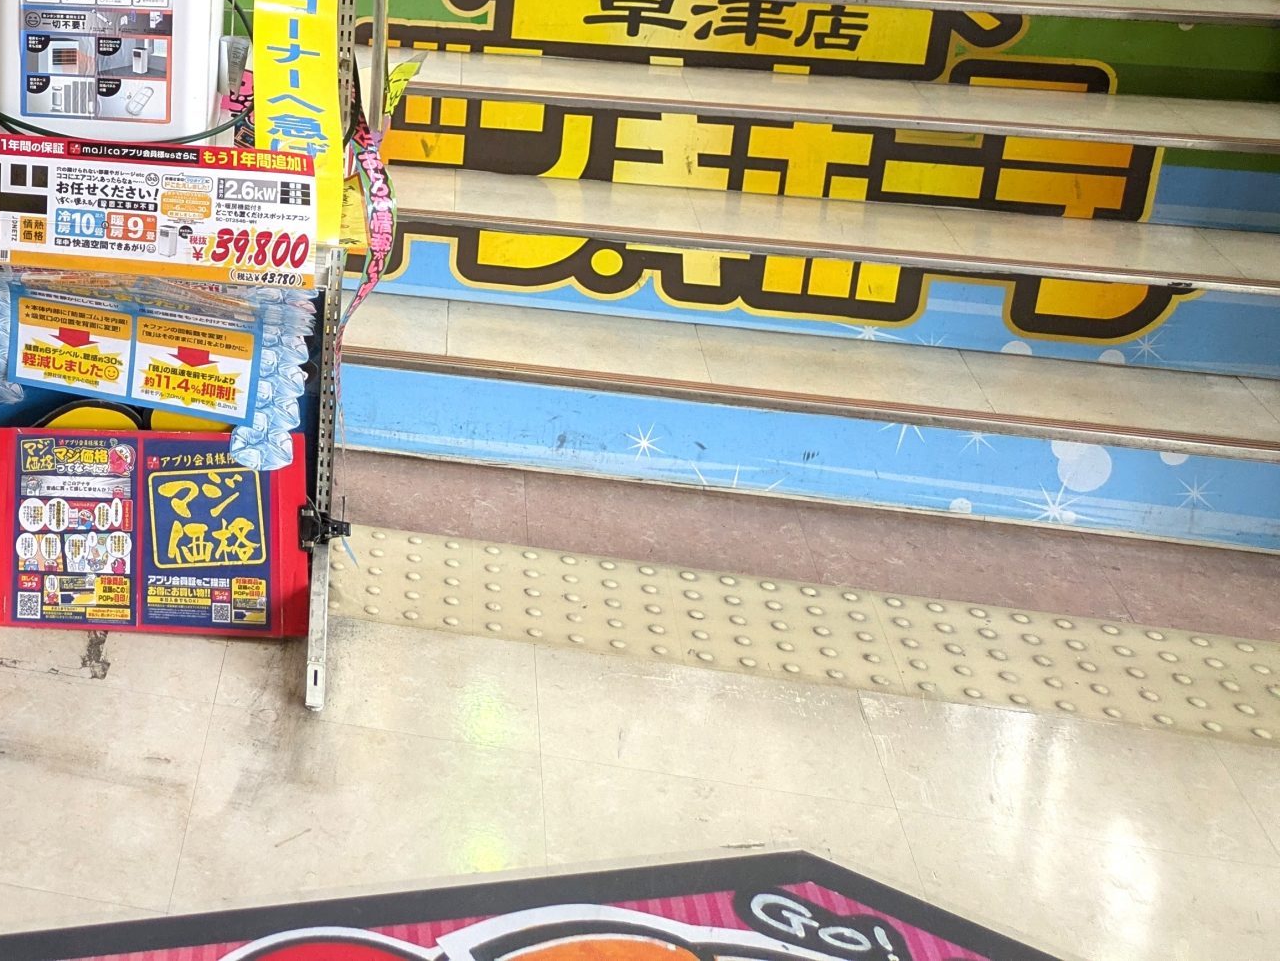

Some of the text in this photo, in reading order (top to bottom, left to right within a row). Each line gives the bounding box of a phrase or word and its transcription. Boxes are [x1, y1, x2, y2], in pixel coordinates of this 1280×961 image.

[203, 150, 307, 172] もう1年間追加!
[55, 181, 160, 201] お任せください!
[225, 180, 277, 202] 2.6kW
[215, 209, 311, 222] どこでも置くだけスポットエアコン
[189, 235, 208, 246] 税抜
[210, 227, 310, 269] 39,800
[22, 352, 104, 379] 軽減しました
[143, 373, 237, 401] 約11.4%抑制!
[53, 446, 109, 464] マジ価格
[157, 471, 243, 519] マジ
[167, 517, 261, 565] 価格
[147, 575, 230, 588] アプリ会員証をご提示!
